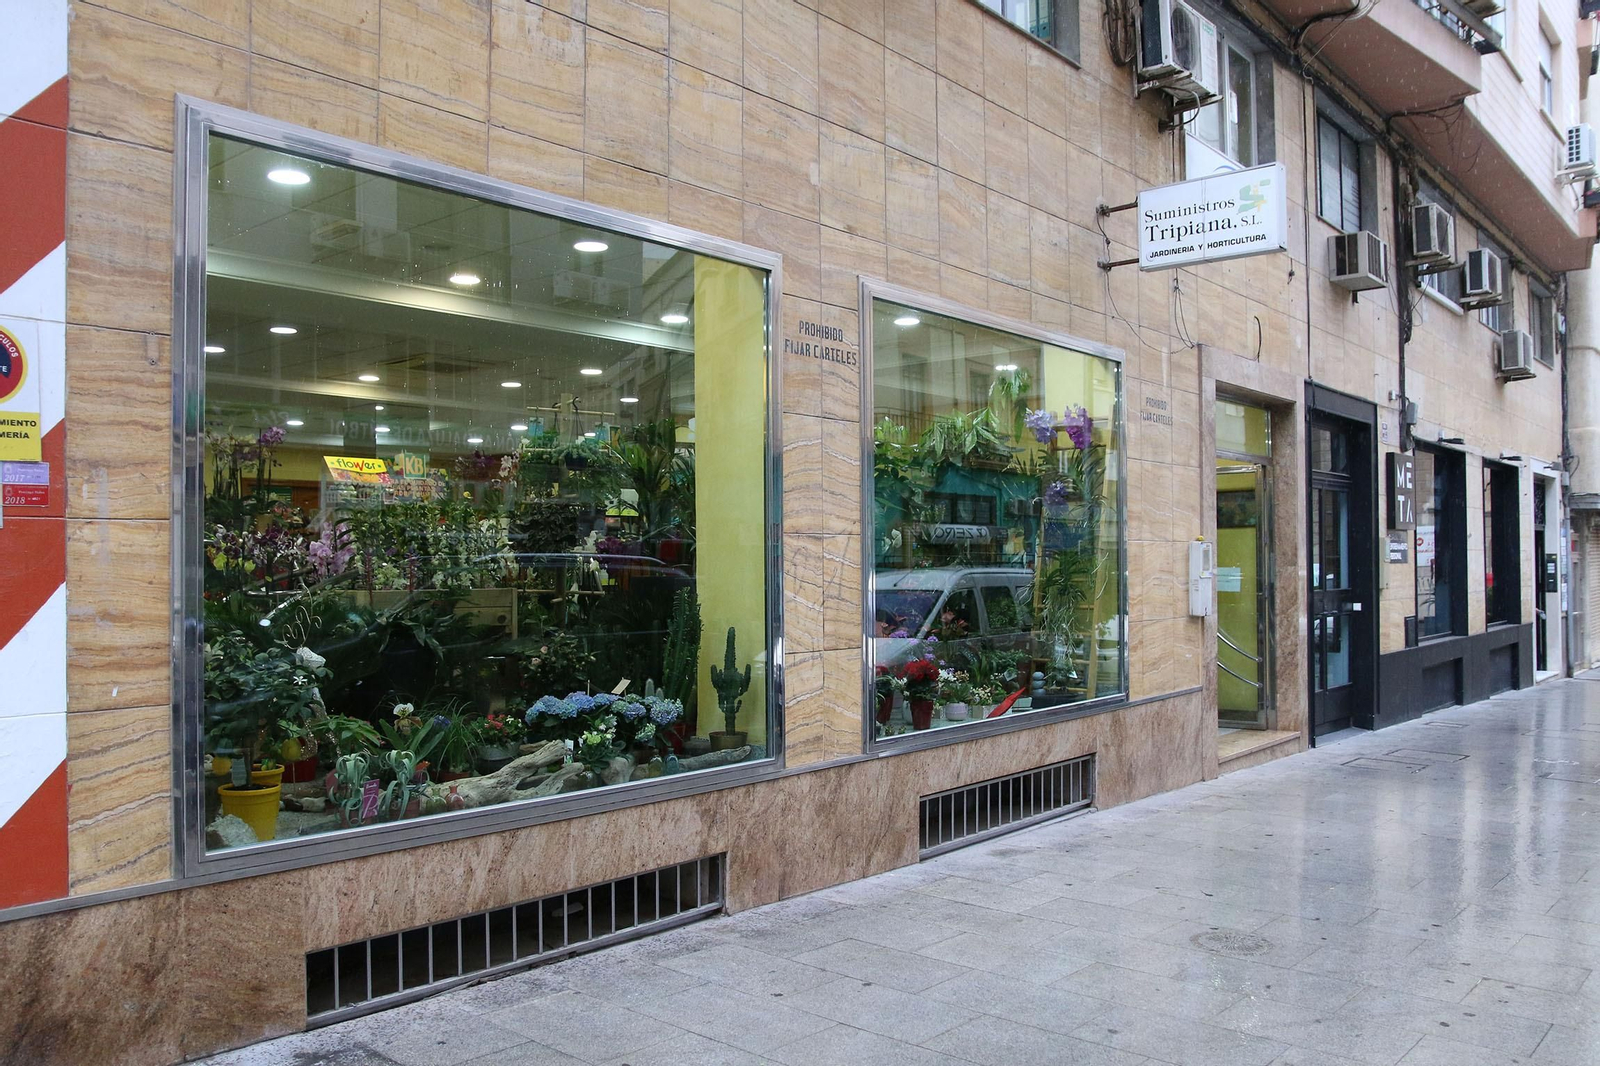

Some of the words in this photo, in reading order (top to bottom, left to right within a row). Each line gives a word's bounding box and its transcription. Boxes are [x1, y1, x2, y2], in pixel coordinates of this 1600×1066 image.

[1144, 198, 1235, 223] Suministros
[1240, 213, 1263, 228] S.L.
[1149, 245, 1195, 259] JARDINERIA
[1198, 243, 1204, 251] Y
[1207, 233, 1267, 249] HORTICULTURA
[798, 320, 843, 343] PROHIBIDO
[784, 338, 811, 357] FIJAR
[813, 344, 857, 366] CARTELES
[336, 458, 376, 471] flower
[405, 455, 424, 475] KB
[3, 474, 26, 482] 2017
[4, 496, 26, 505] 2018
